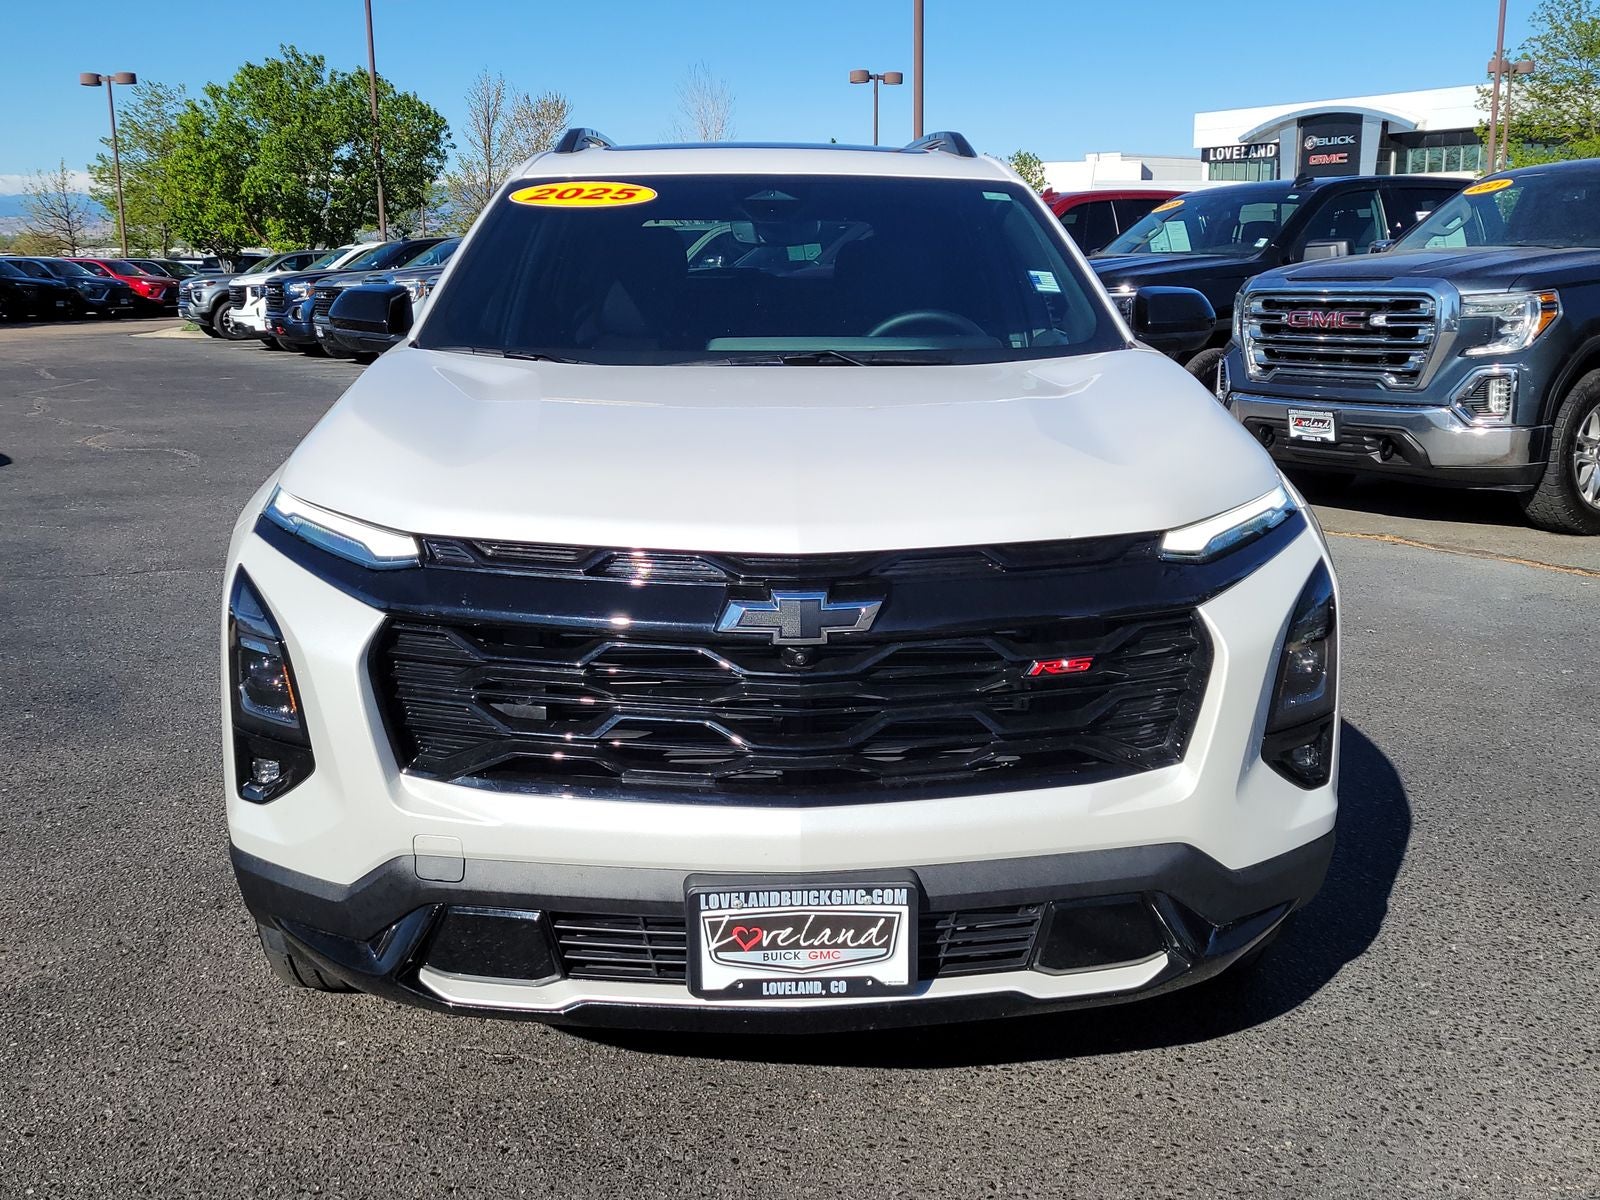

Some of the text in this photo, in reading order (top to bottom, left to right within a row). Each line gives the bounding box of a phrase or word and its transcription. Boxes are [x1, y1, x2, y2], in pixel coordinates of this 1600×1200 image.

[1316, 135, 1356, 146] BUICK
[1209, 144, 1276, 161] LOVELAND
[1309, 153, 1348, 165] GMC
[525, 187, 641, 200] 2025
[1288, 310, 1366, 329] GMC
[1028, 656, 1093, 676] RS
[700, 889, 907, 909] LOVELANDBUICKGMCCOM
[762, 950, 841, 962] BUICK GMC
[762, 981, 847, 995] LOVELAND, CO
